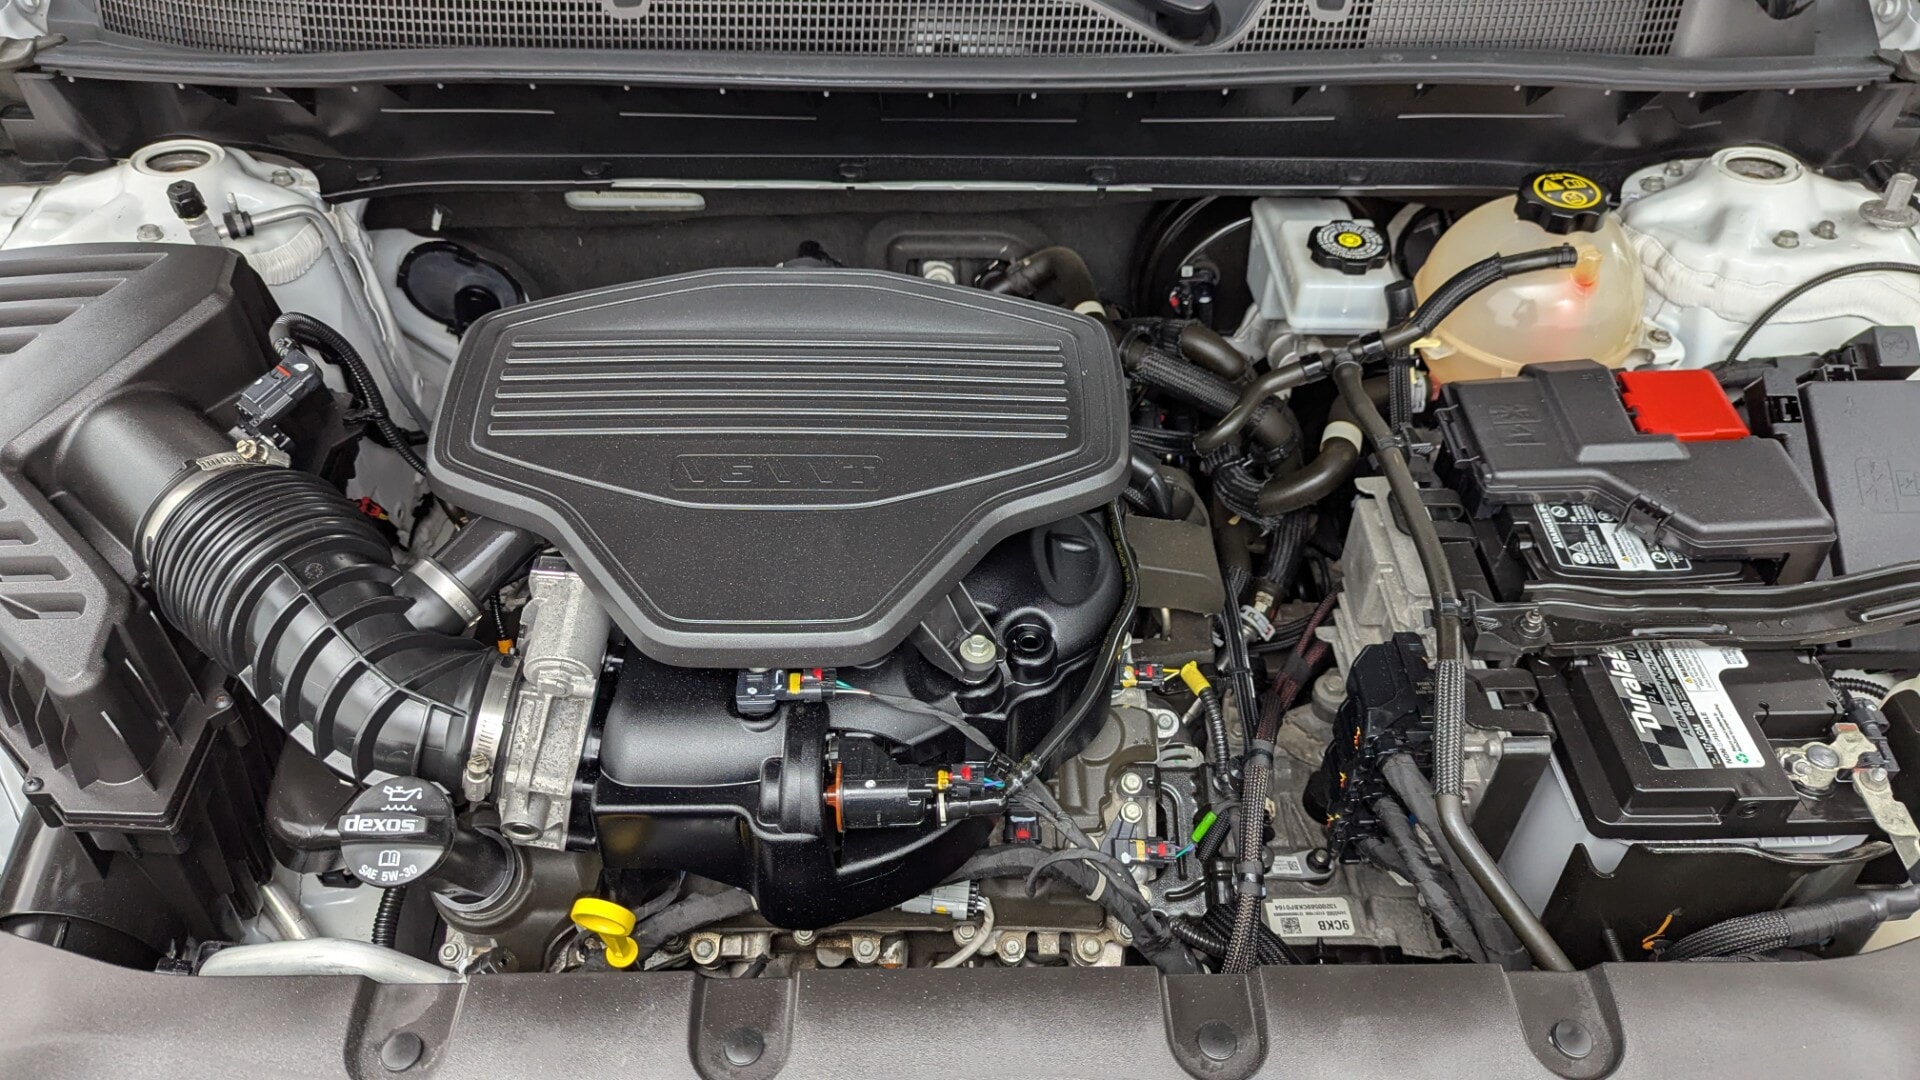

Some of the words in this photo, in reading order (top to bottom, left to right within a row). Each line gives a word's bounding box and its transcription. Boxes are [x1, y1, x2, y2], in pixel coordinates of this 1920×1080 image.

[1682, 702, 1695, 716] 850
[1674, 711, 1693, 737] AGM
[1692, 723, 1714, 752] H7-AGM
[345, 815, 416, 832] dexos
[358, 864, 379, 880] SAE
[381, 864, 418, 882] 5W-30
[1318, 919, 1349, 930] 9CKB
